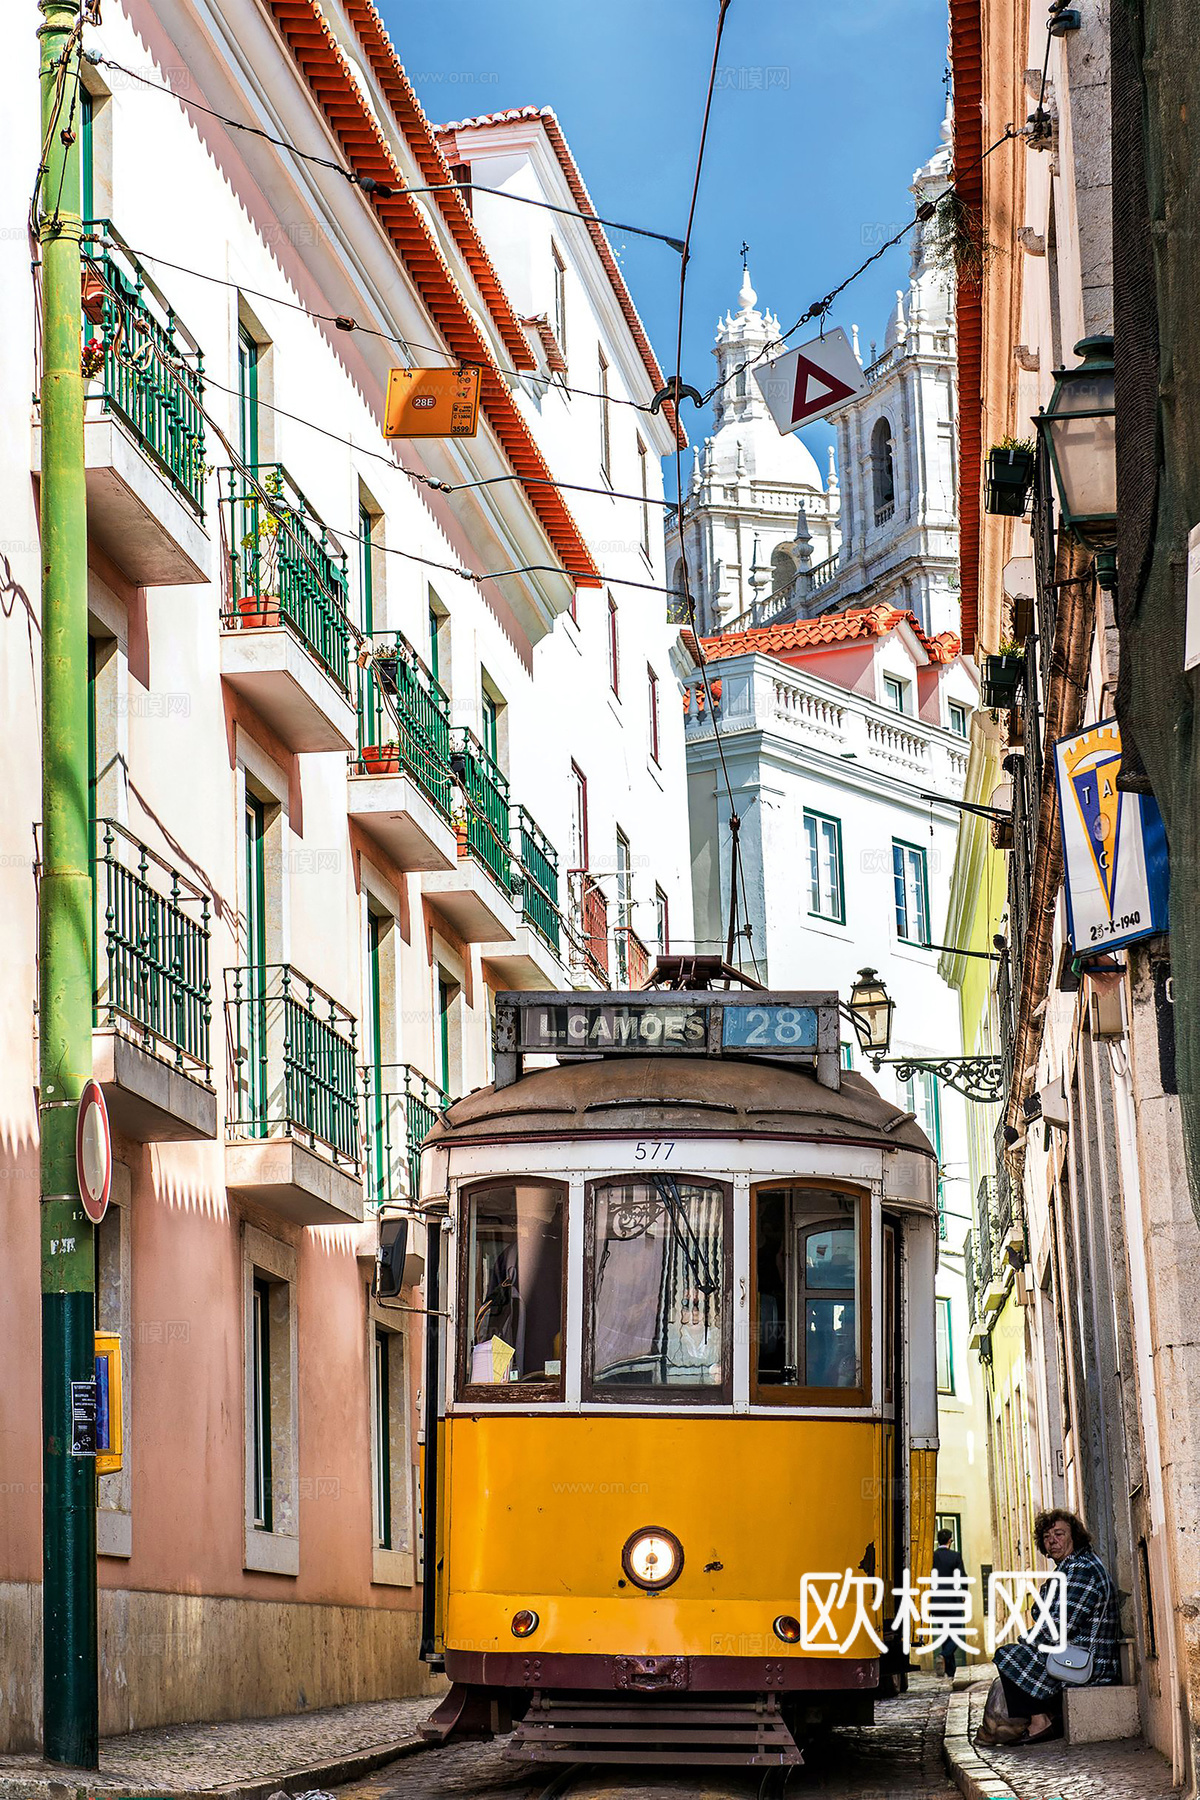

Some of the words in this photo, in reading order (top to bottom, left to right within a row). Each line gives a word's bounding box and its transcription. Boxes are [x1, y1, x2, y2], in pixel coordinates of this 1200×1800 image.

[415, 398, 433, 406] 28E
[1082, 785, 1091, 804] T
[1102, 778, 1112, 799] A
[1099, 850, 1109, 869] C
[745, 1008, 802, 1044] 28
[634, 1142, 675, 1161] 577
